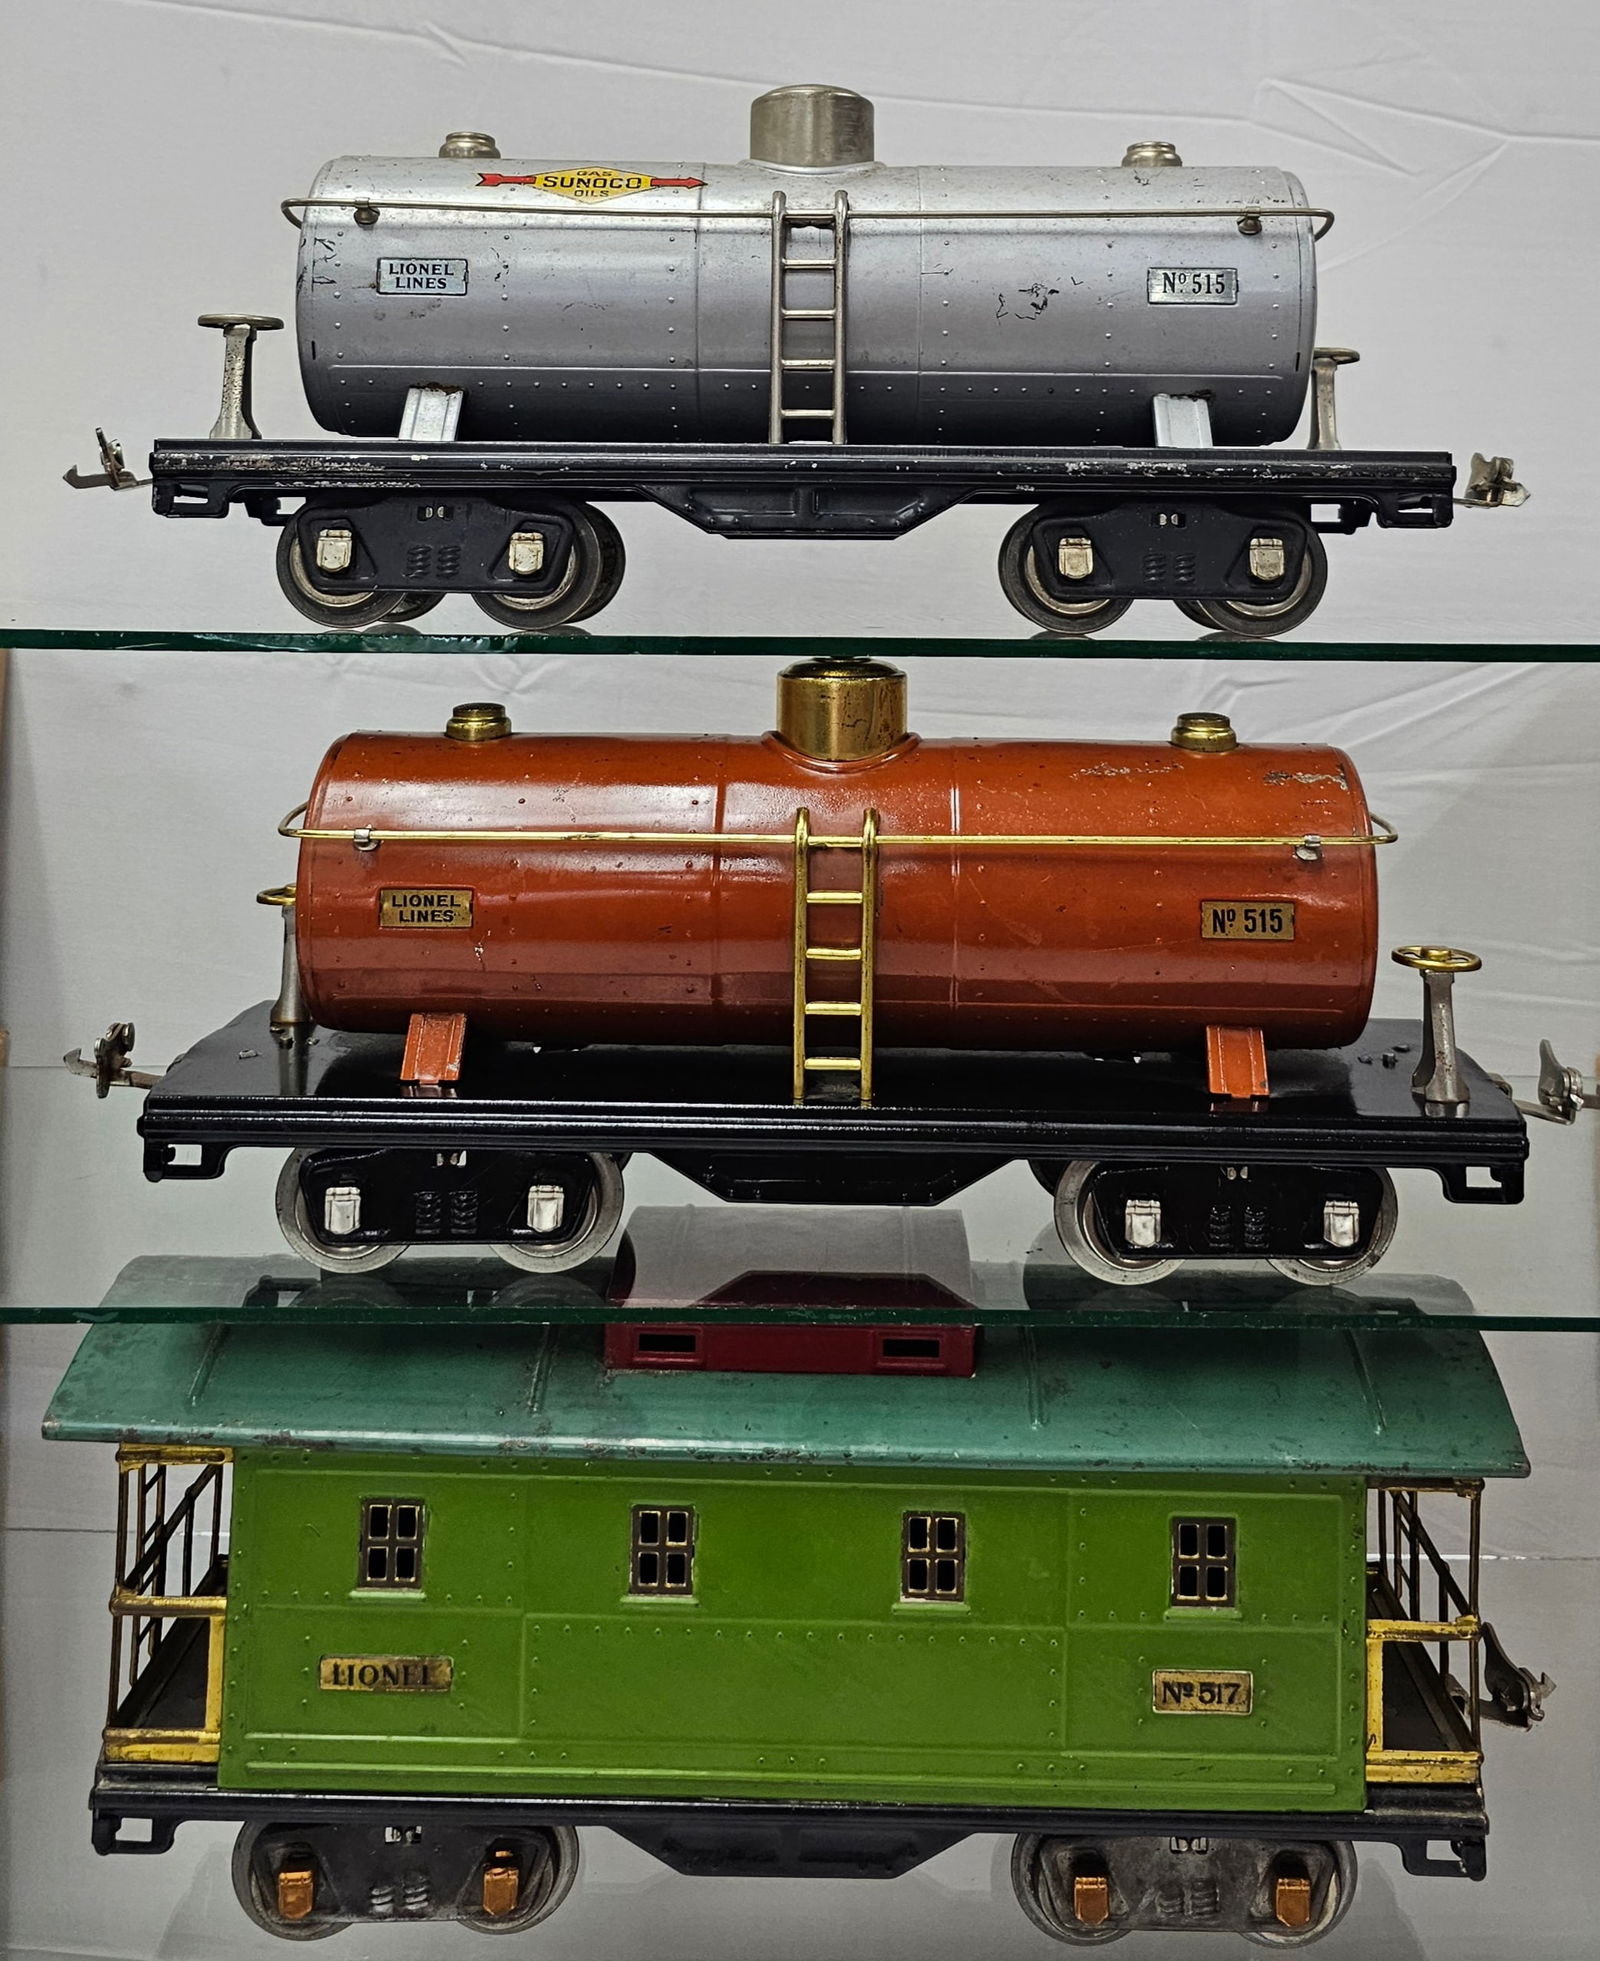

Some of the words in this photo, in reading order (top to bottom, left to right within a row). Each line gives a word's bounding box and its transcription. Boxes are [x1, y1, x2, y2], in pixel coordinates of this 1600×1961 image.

[543, 176, 642, 188] SUNOCO
[574, 189, 610, 197] OILS
[389, 263, 454, 276] LIONEL
[395, 277, 447, 289] LINES
[1192, 273, 1225, 294] 515
[391, 894, 461, 907] LIONEL
[399, 909, 455, 922] LINES
[1243, 908, 1283, 933] 515
[1198, 1681, 1241, 1704] 517
